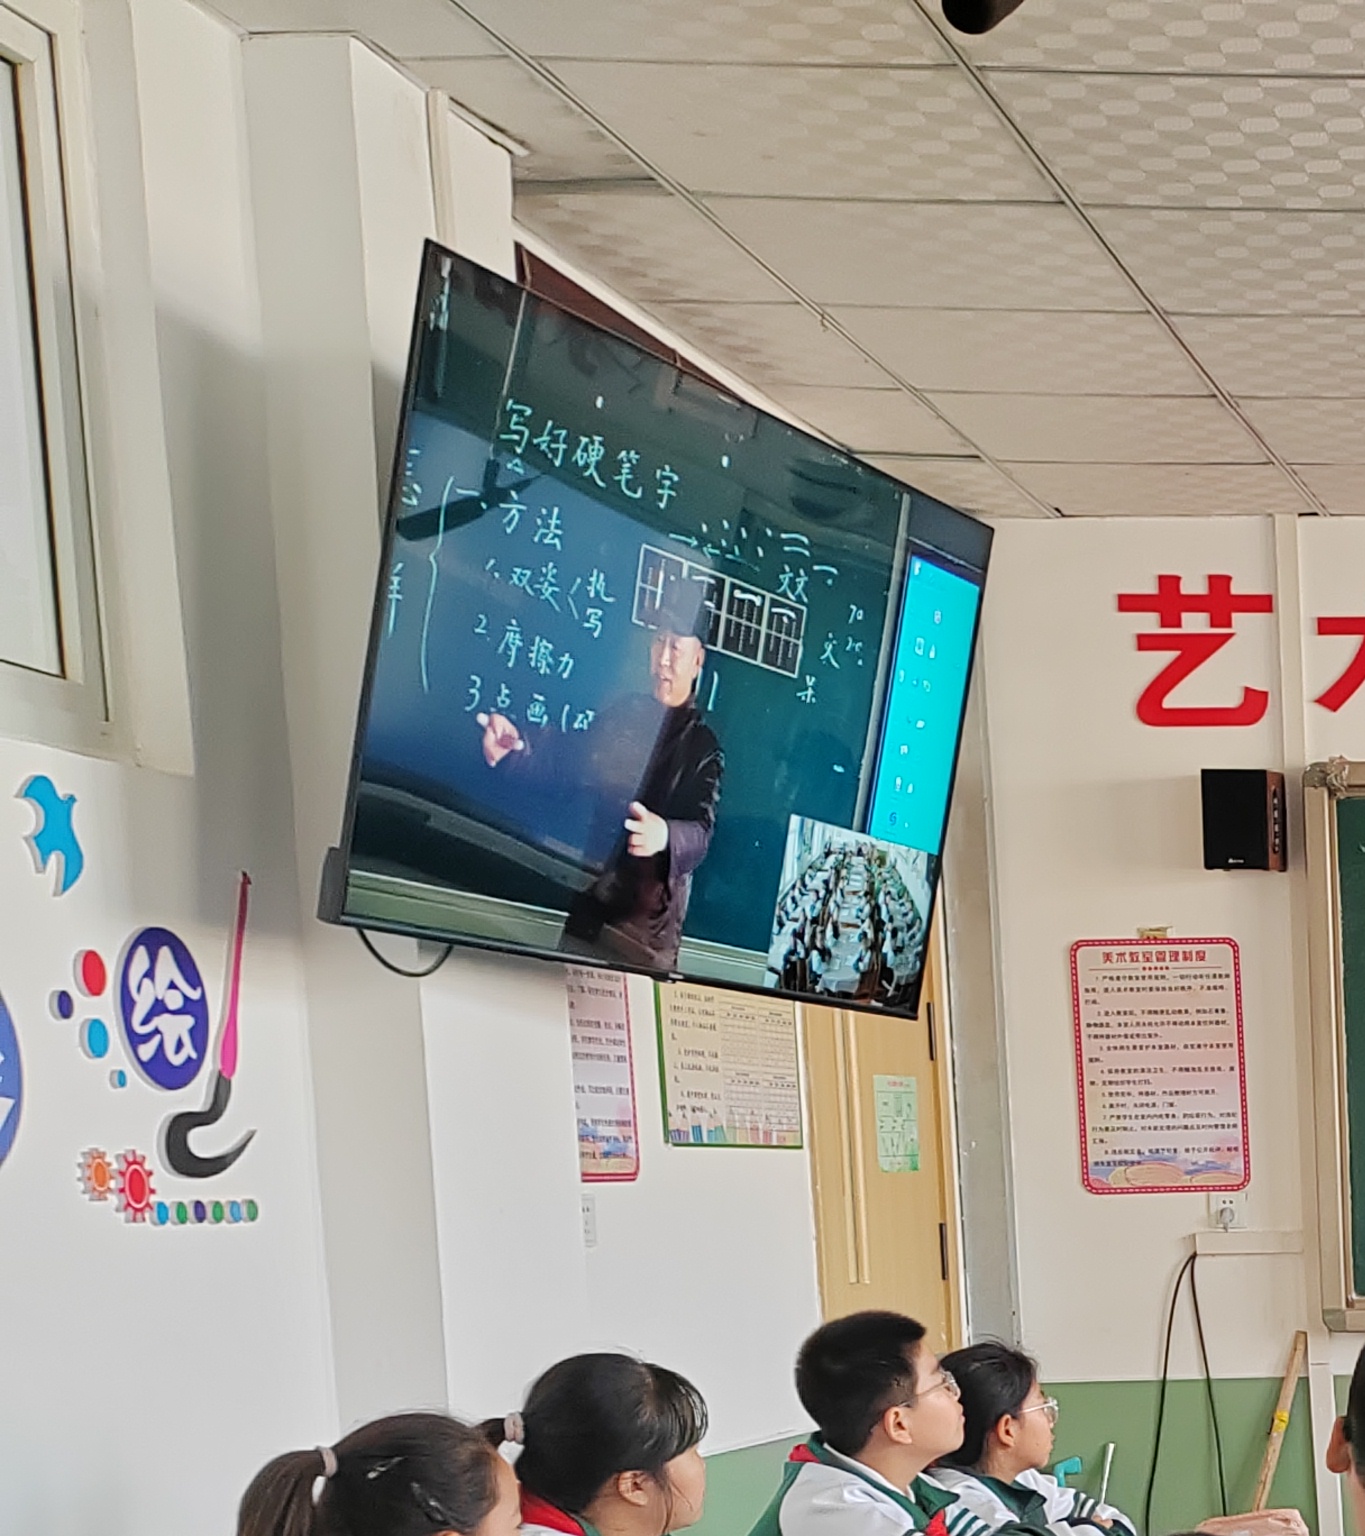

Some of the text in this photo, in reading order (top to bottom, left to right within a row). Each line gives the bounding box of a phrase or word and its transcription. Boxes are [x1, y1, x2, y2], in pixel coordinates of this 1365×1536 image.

[499, 398, 680, 509] 写好硬笔字
[1102, 950, 1206, 964] 美术教室管理制度
